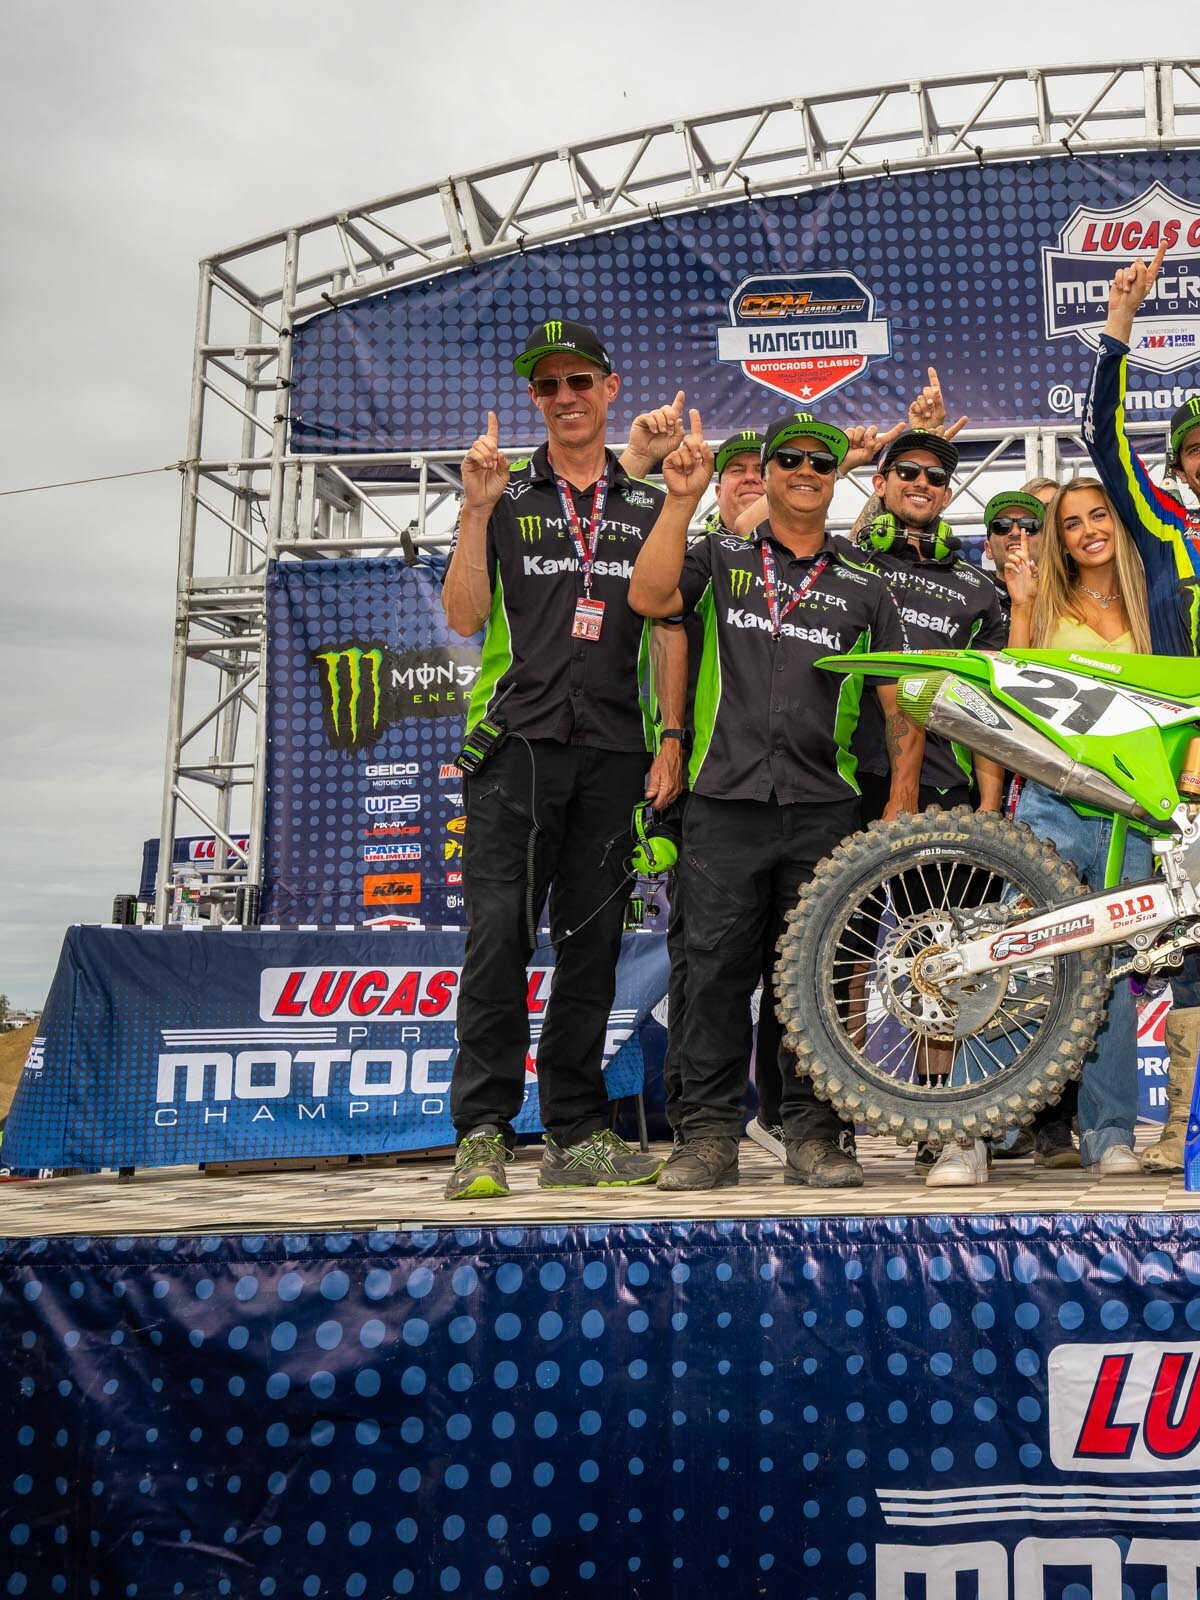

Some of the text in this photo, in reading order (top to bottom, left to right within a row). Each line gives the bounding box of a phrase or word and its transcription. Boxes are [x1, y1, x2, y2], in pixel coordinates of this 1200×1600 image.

[1082, 218, 1181, 252] LUCAS
[749, 330, 857, 353] HANGTOWN
[1136, 334, 1195, 349] AMA PRO
[751, 358, 860, 372] MOTOCROSS CLASSIC
[784, 427, 842, 446] Kawasaki
[727, 608, 841, 652] Kawasaki
[1069, 653, 1122, 675] Kawasaki
[391, 660, 482, 691] MONS
[413, 690, 473, 704] ENER
[1001, 669, 1119, 735] 21
[365, 763, 419, 777] GEICO
[372, 779, 413, 787] MOTORCYCLE
[366, 796, 420, 814] WPS
[365, 844, 420, 854] PARTS
[889, 832, 970, 853] DUNLOP
[365, 853, 420, 862] UNLIMITED
[372, 882, 412, 896] KTM
[272, 970, 459, 1016] LUCAS
[350, 1027, 459, 1043] PR
[157, 1049, 457, 1102] MOTOC
